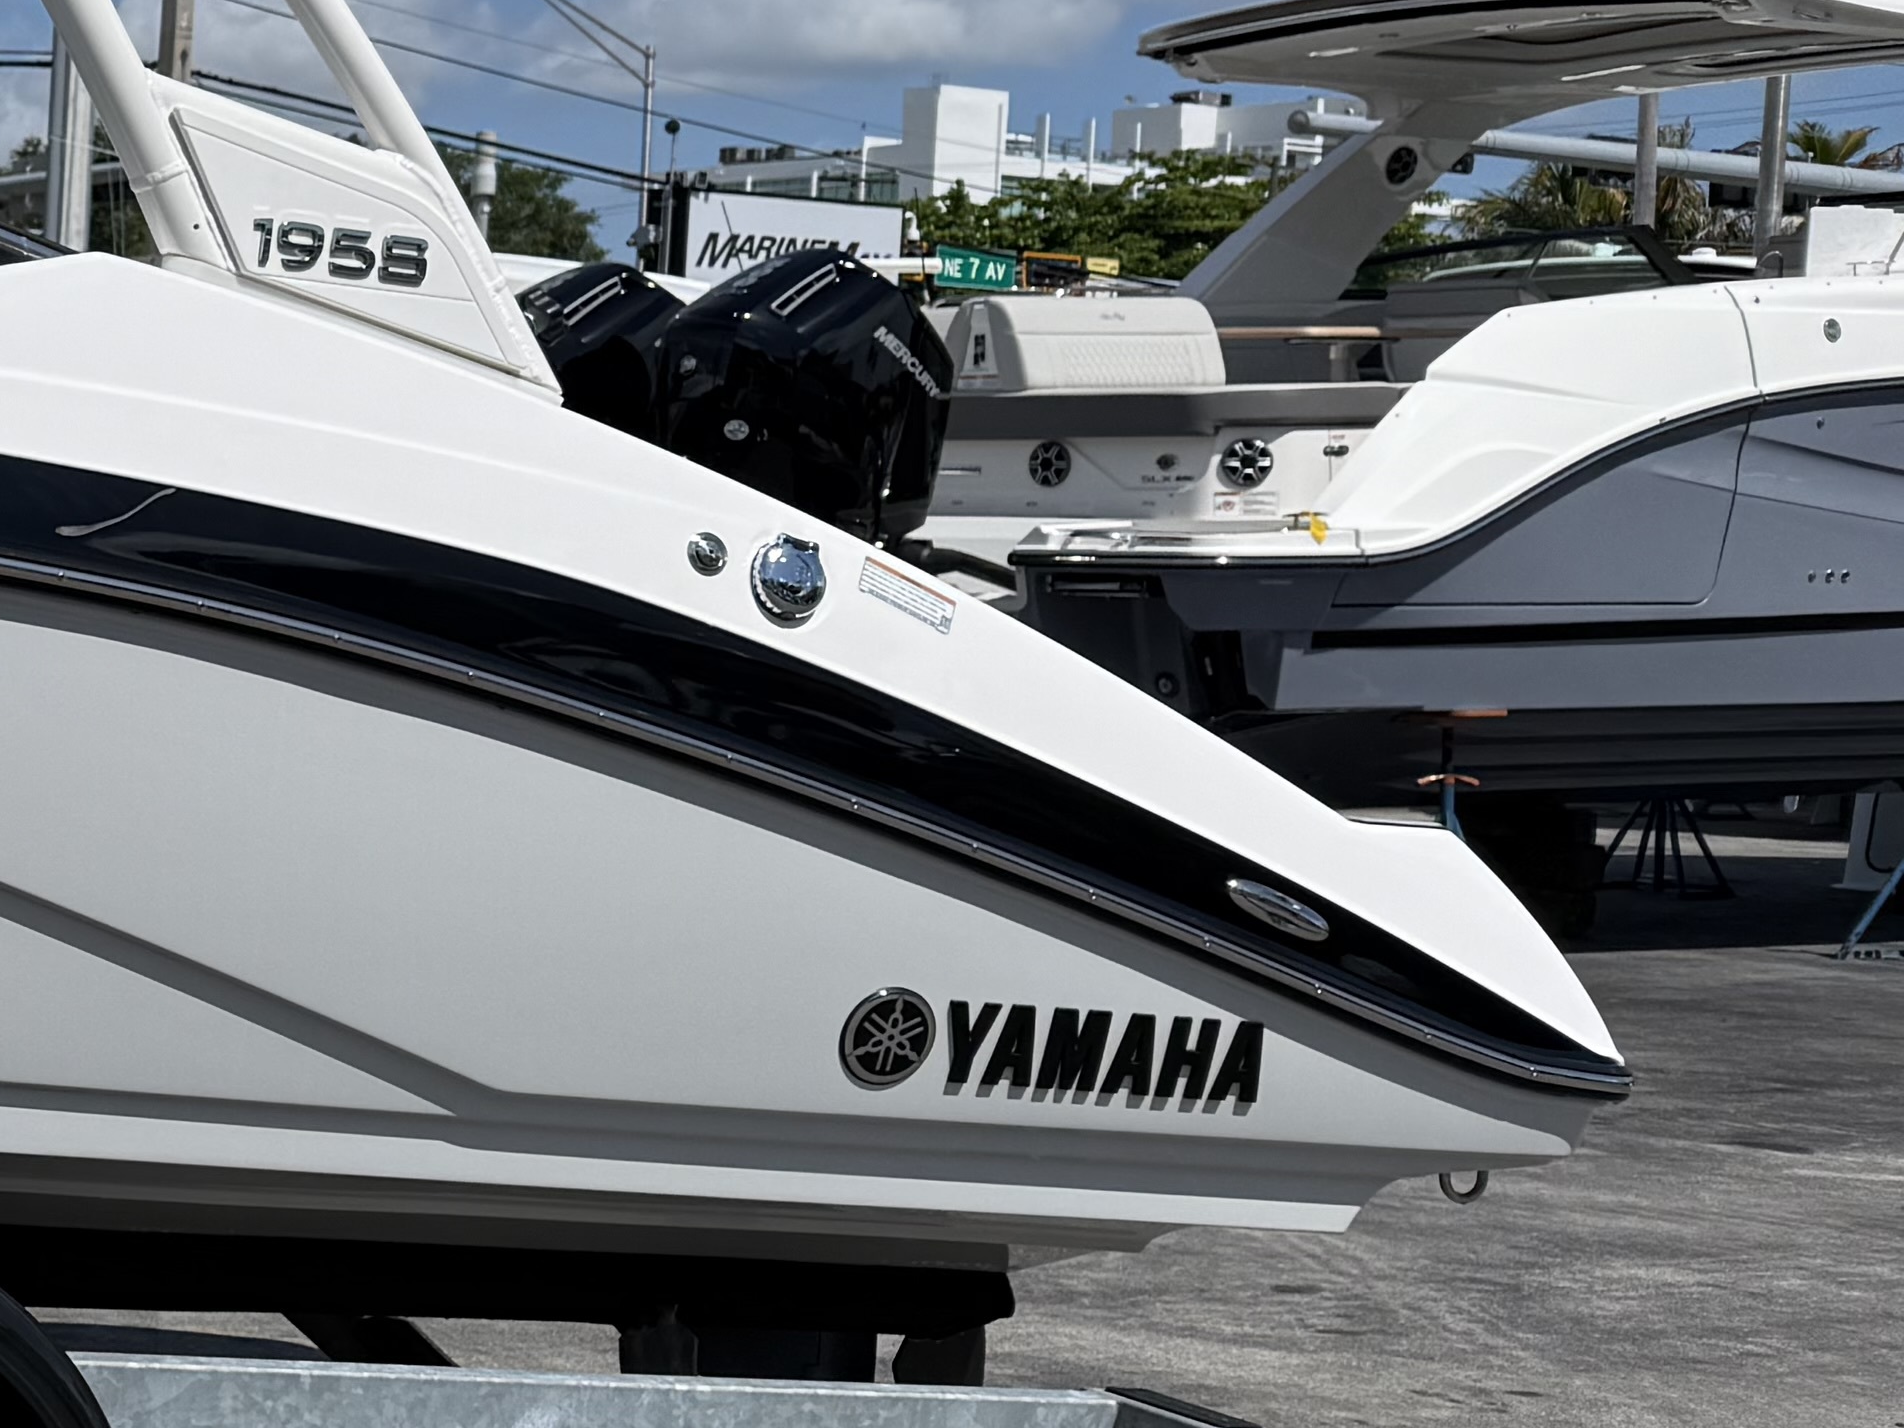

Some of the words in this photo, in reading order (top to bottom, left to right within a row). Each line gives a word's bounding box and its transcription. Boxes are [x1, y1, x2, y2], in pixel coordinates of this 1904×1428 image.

[696, 232, 893, 268] MARIN
[944, 258, 963, 278] NE
[970, 257, 980, 279] 7
[985, 261, 1006, 281] AV
[874, 326, 940, 397] MERCURY
[948, 1000, 1265, 1104] YAMAHA
